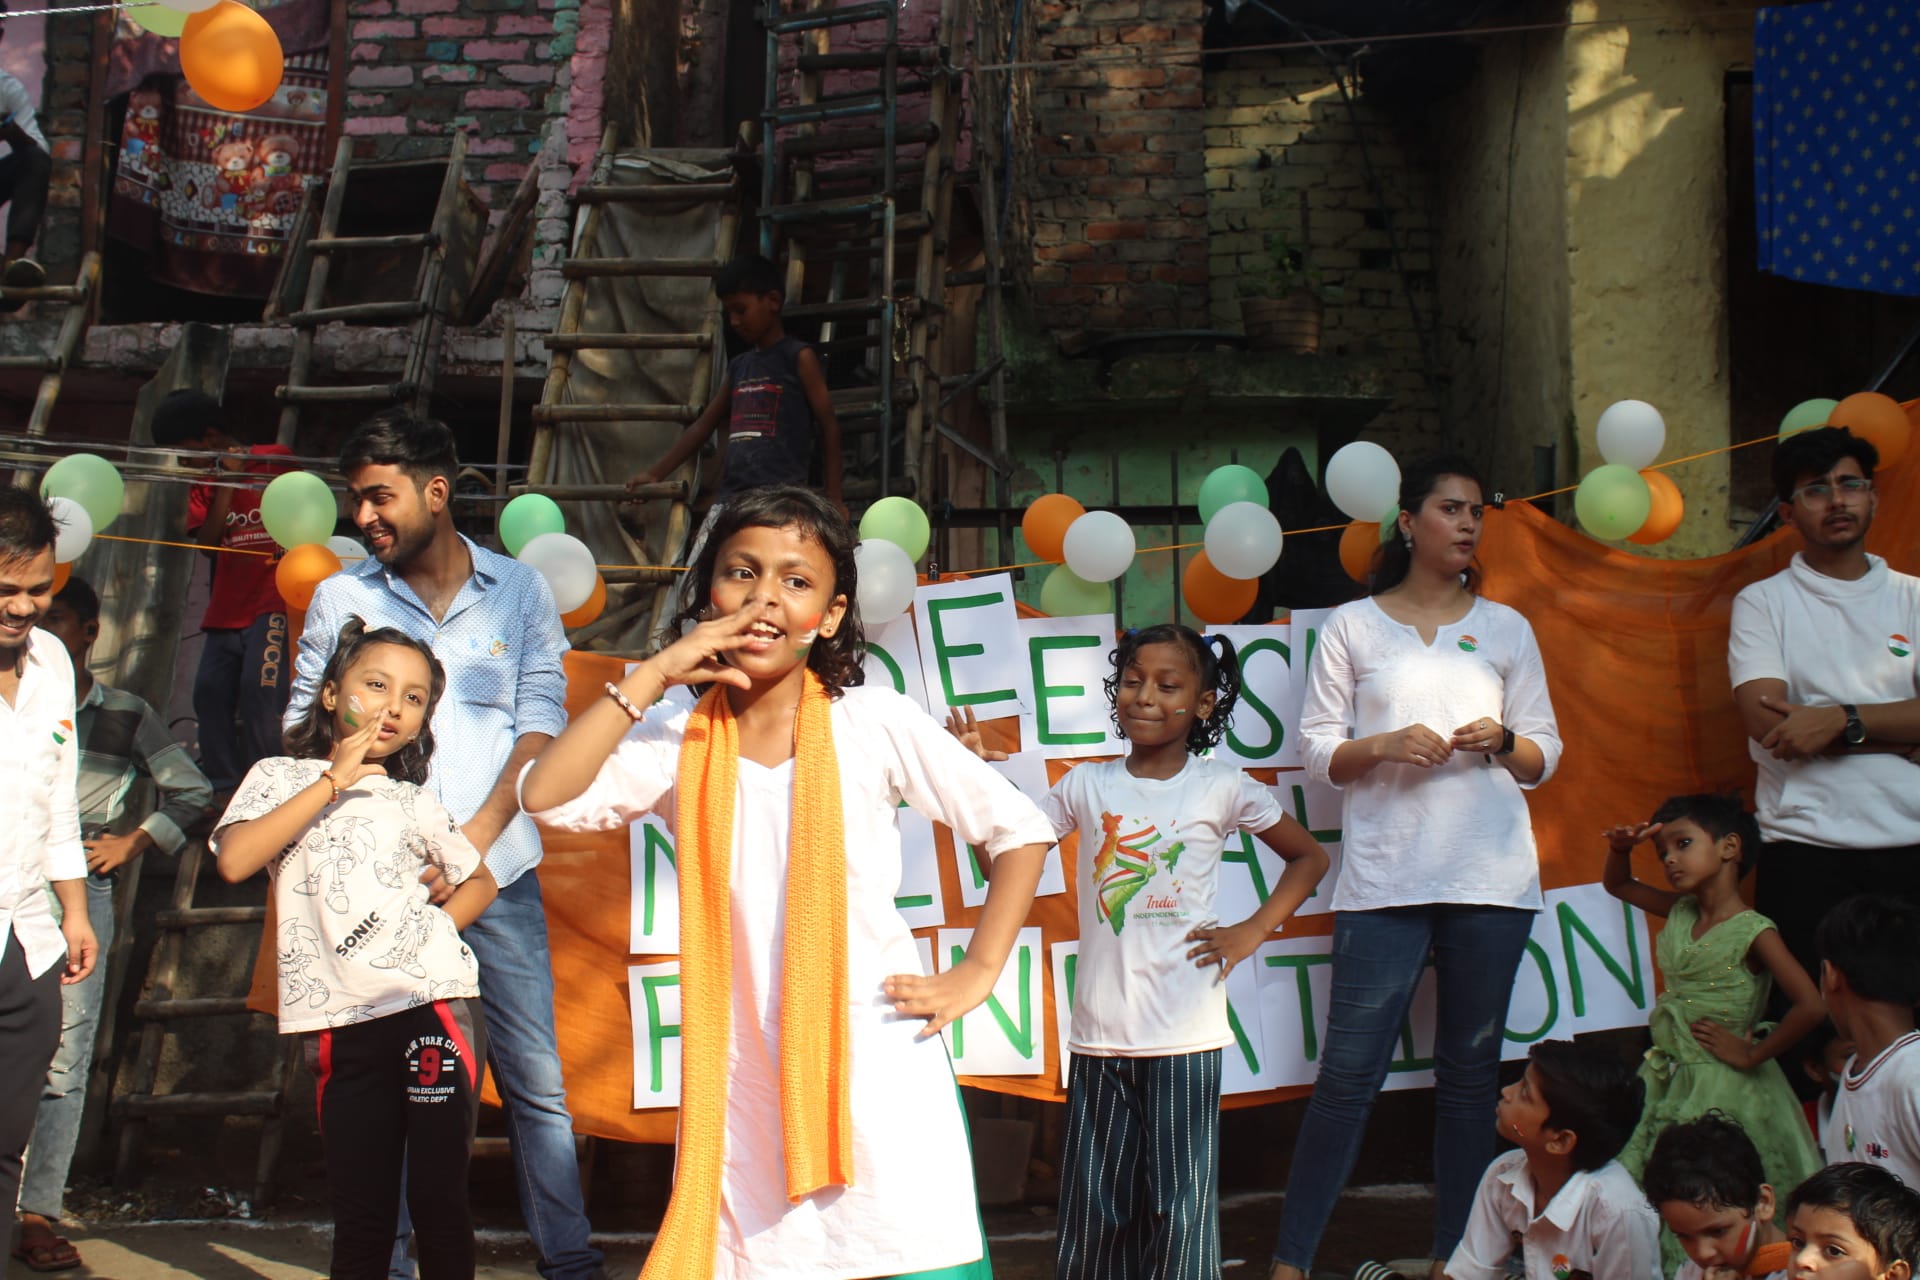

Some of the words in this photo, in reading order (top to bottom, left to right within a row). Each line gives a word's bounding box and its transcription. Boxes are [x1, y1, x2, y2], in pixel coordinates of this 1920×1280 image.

[260, 613, 287, 688] GUCCI
[1146, 895, 1177, 909] India
[336, 911, 380, 957] SONIC
[419, 1036, 443, 1046] YORK
[444, 1039, 461, 1056] CITY
[418, 1047, 440, 1086] 9
[421, 1086, 455, 1094] EXCLUSIVE
[430, 1095, 448, 1103] DEPT
